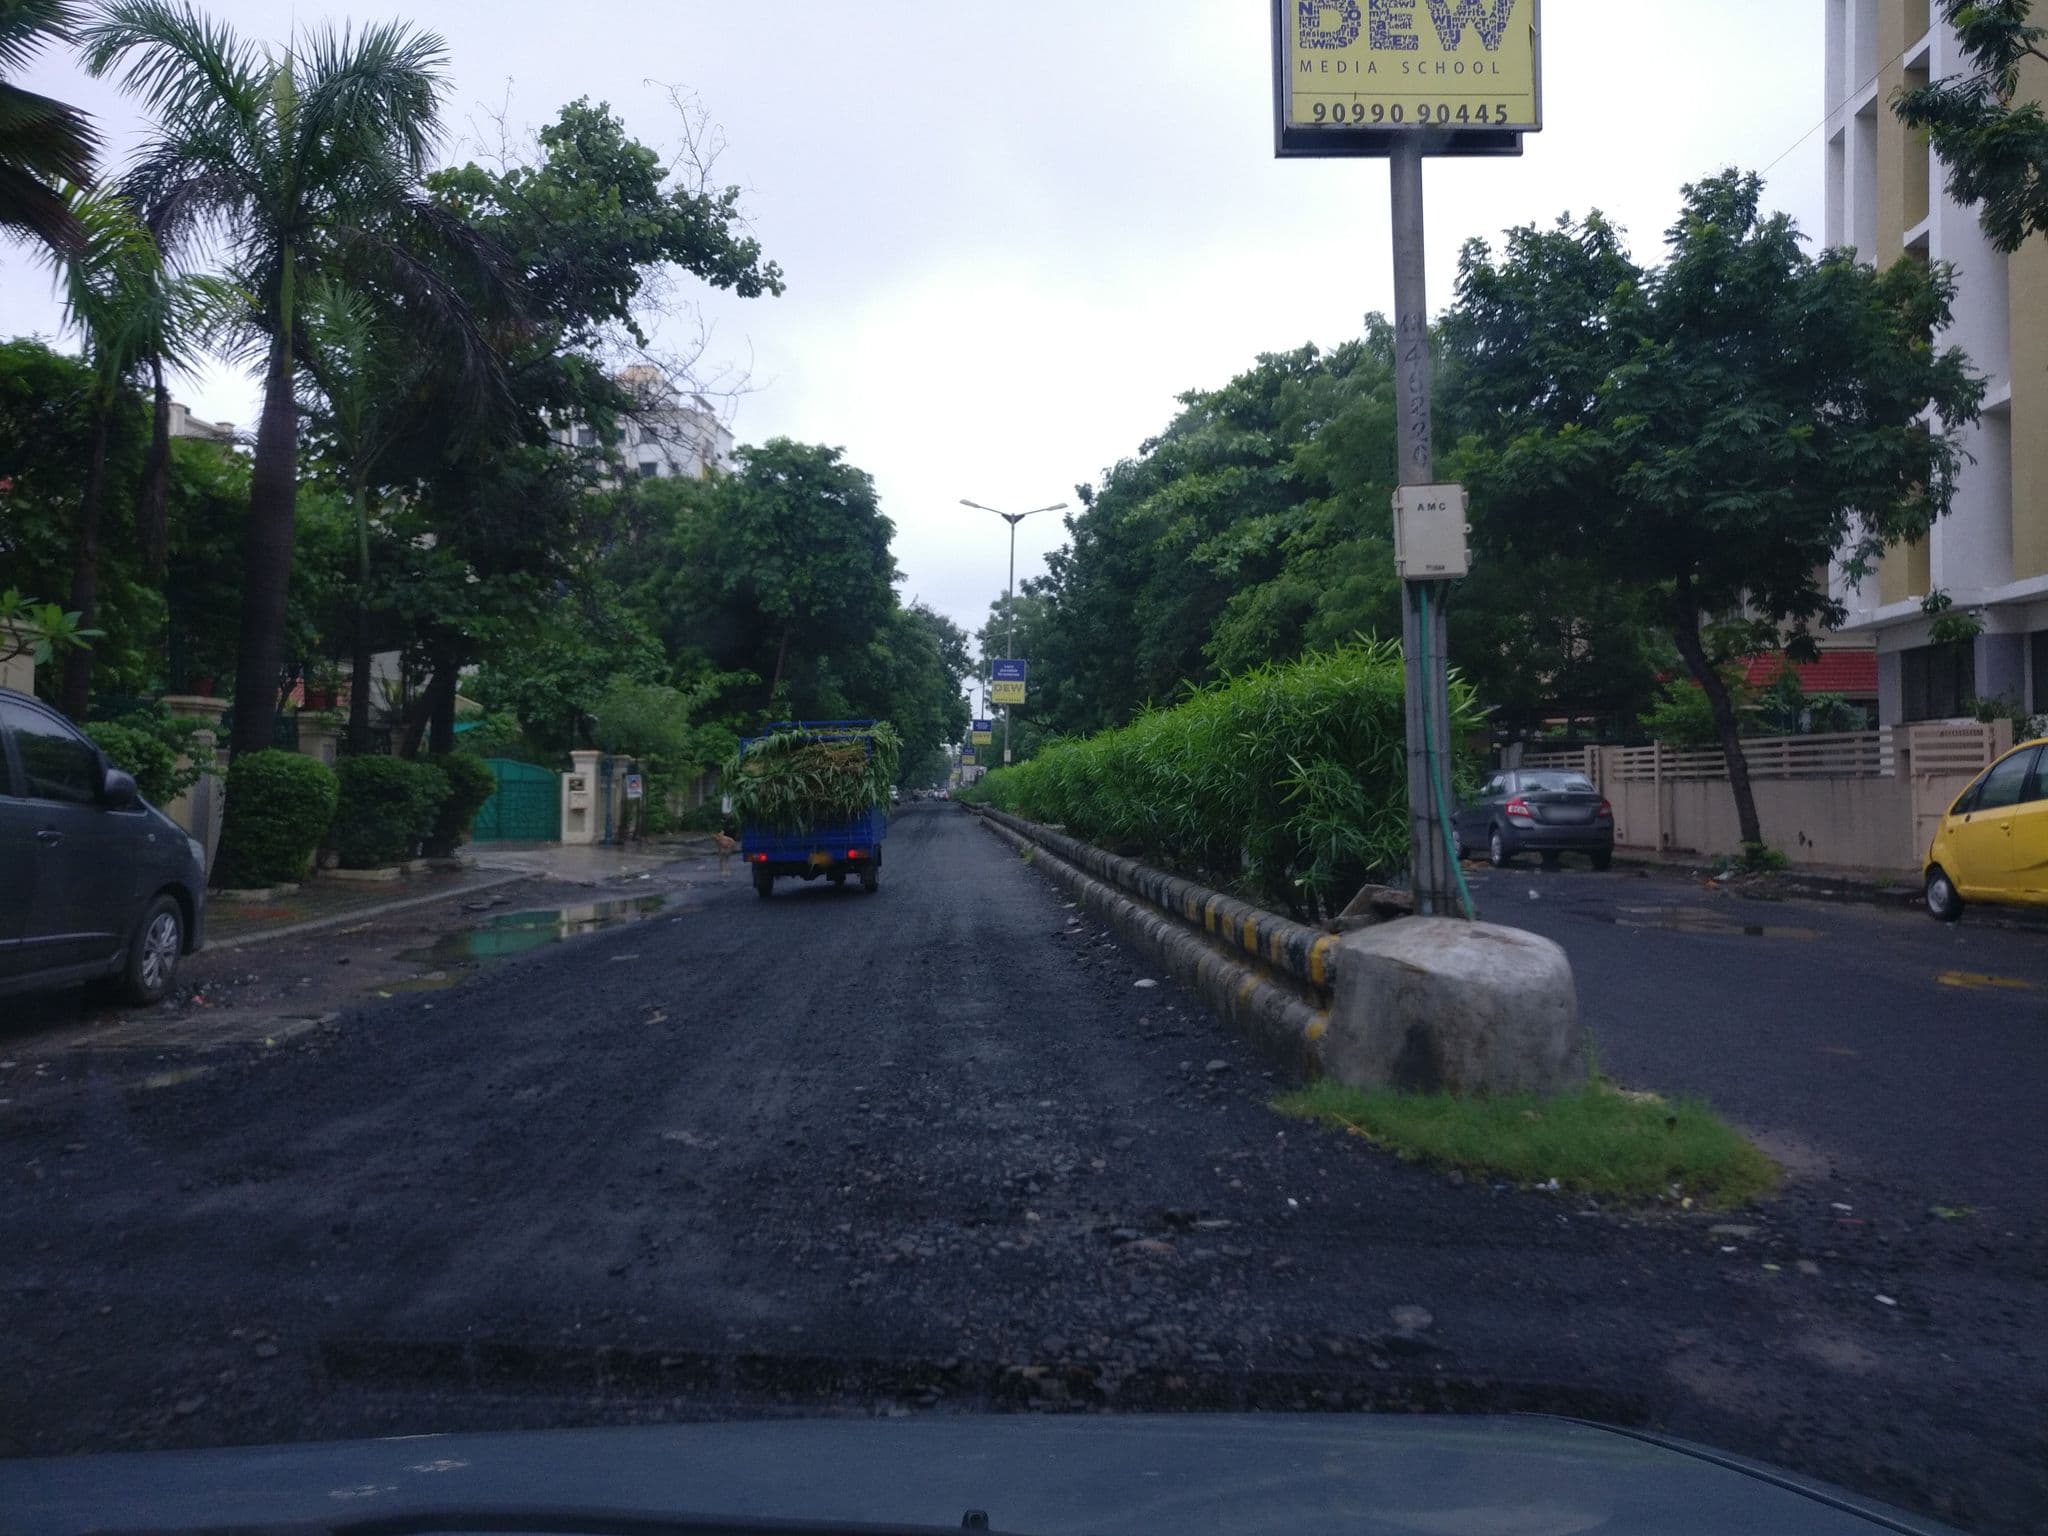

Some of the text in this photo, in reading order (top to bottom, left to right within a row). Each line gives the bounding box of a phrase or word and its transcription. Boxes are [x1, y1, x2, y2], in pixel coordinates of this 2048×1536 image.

[1299, 0, 1515, 51] DEW
[1300, 60, 1500, 74] MEDIA SCHOOL
[1313, 102, 1508, 124] 90990 90445
[1417, 502, 1447, 512] AMC
[994, 683, 1023, 692] DEW
